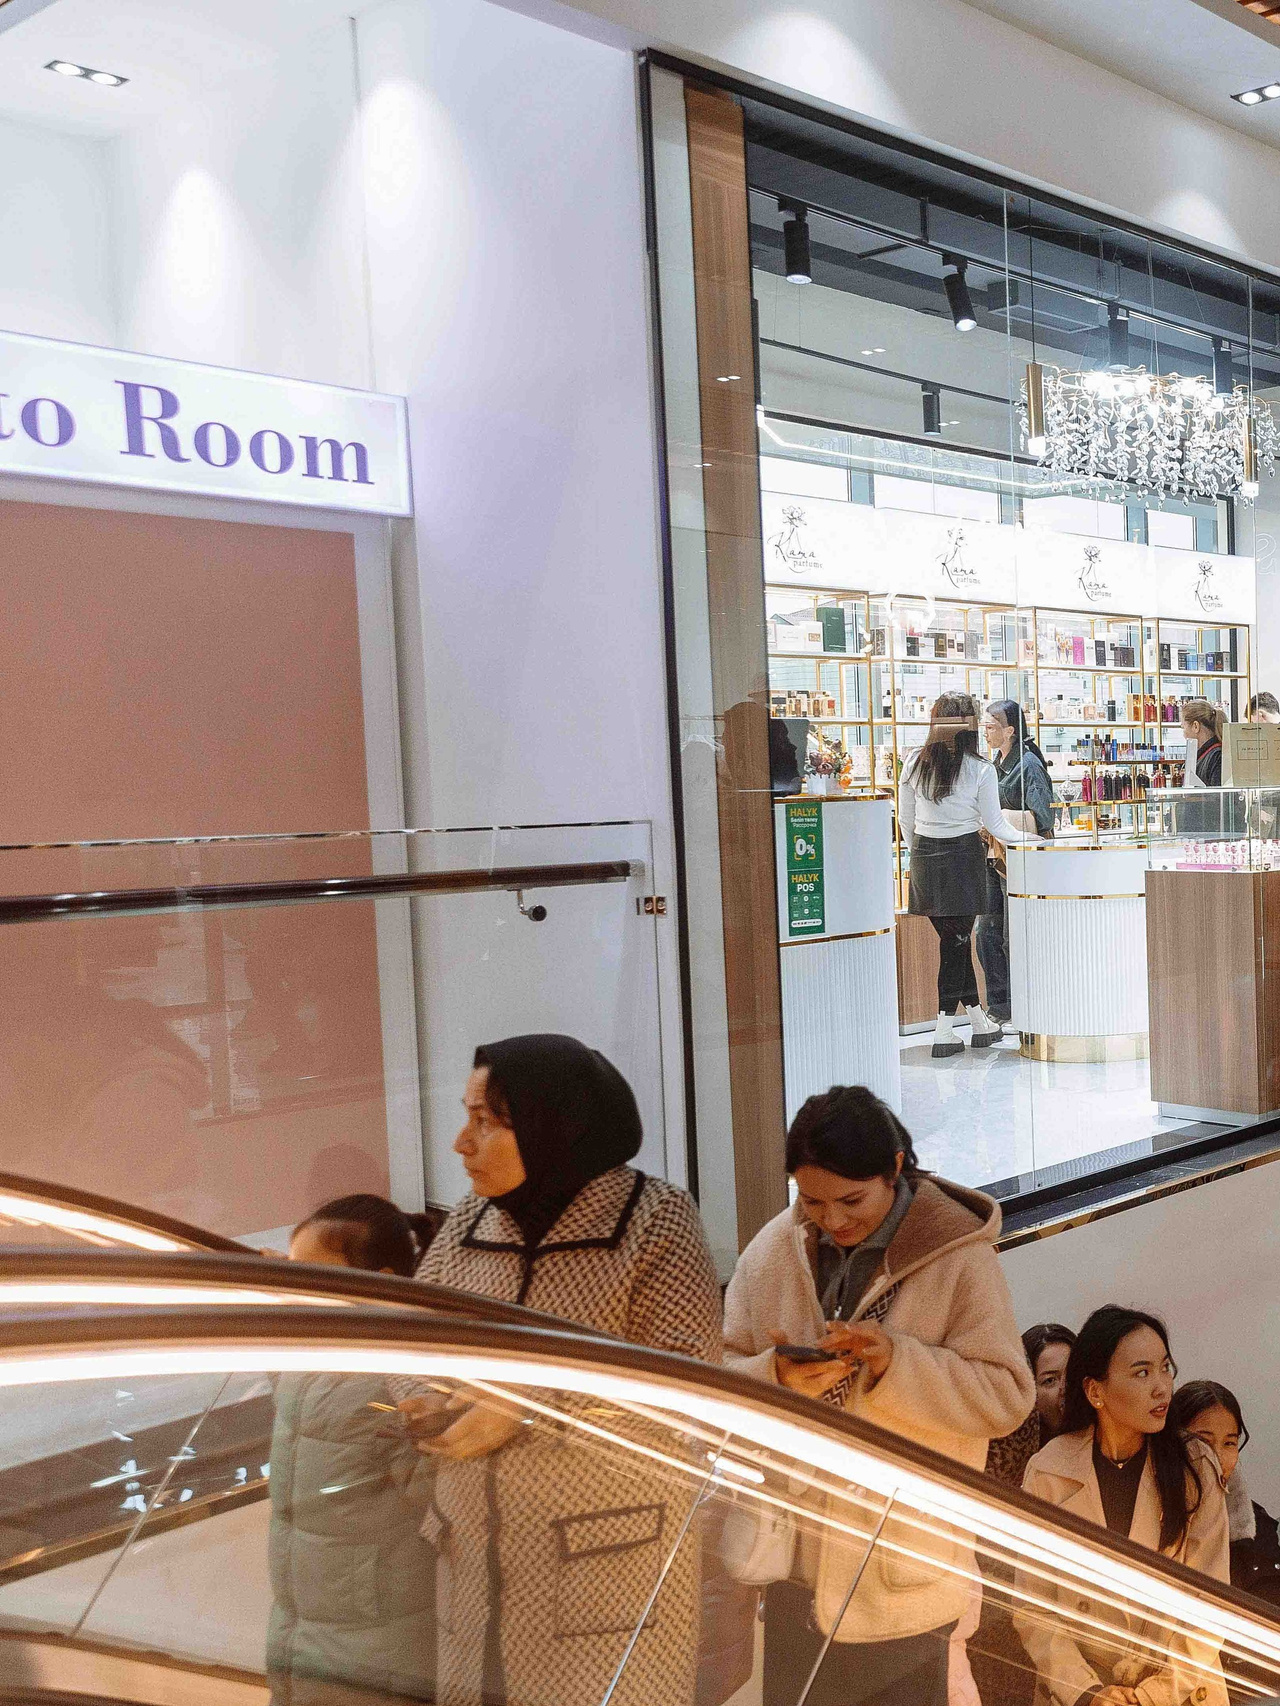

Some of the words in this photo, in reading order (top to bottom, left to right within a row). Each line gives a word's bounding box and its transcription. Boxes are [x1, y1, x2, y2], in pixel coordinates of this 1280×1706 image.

[115, 380, 375, 486] Room
[790, 807, 818, 817] HALYK
[795, 838, 815, 856] 0%
[791, 873, 819, 883] HALYK
[797, 883, 815, 892] POS
